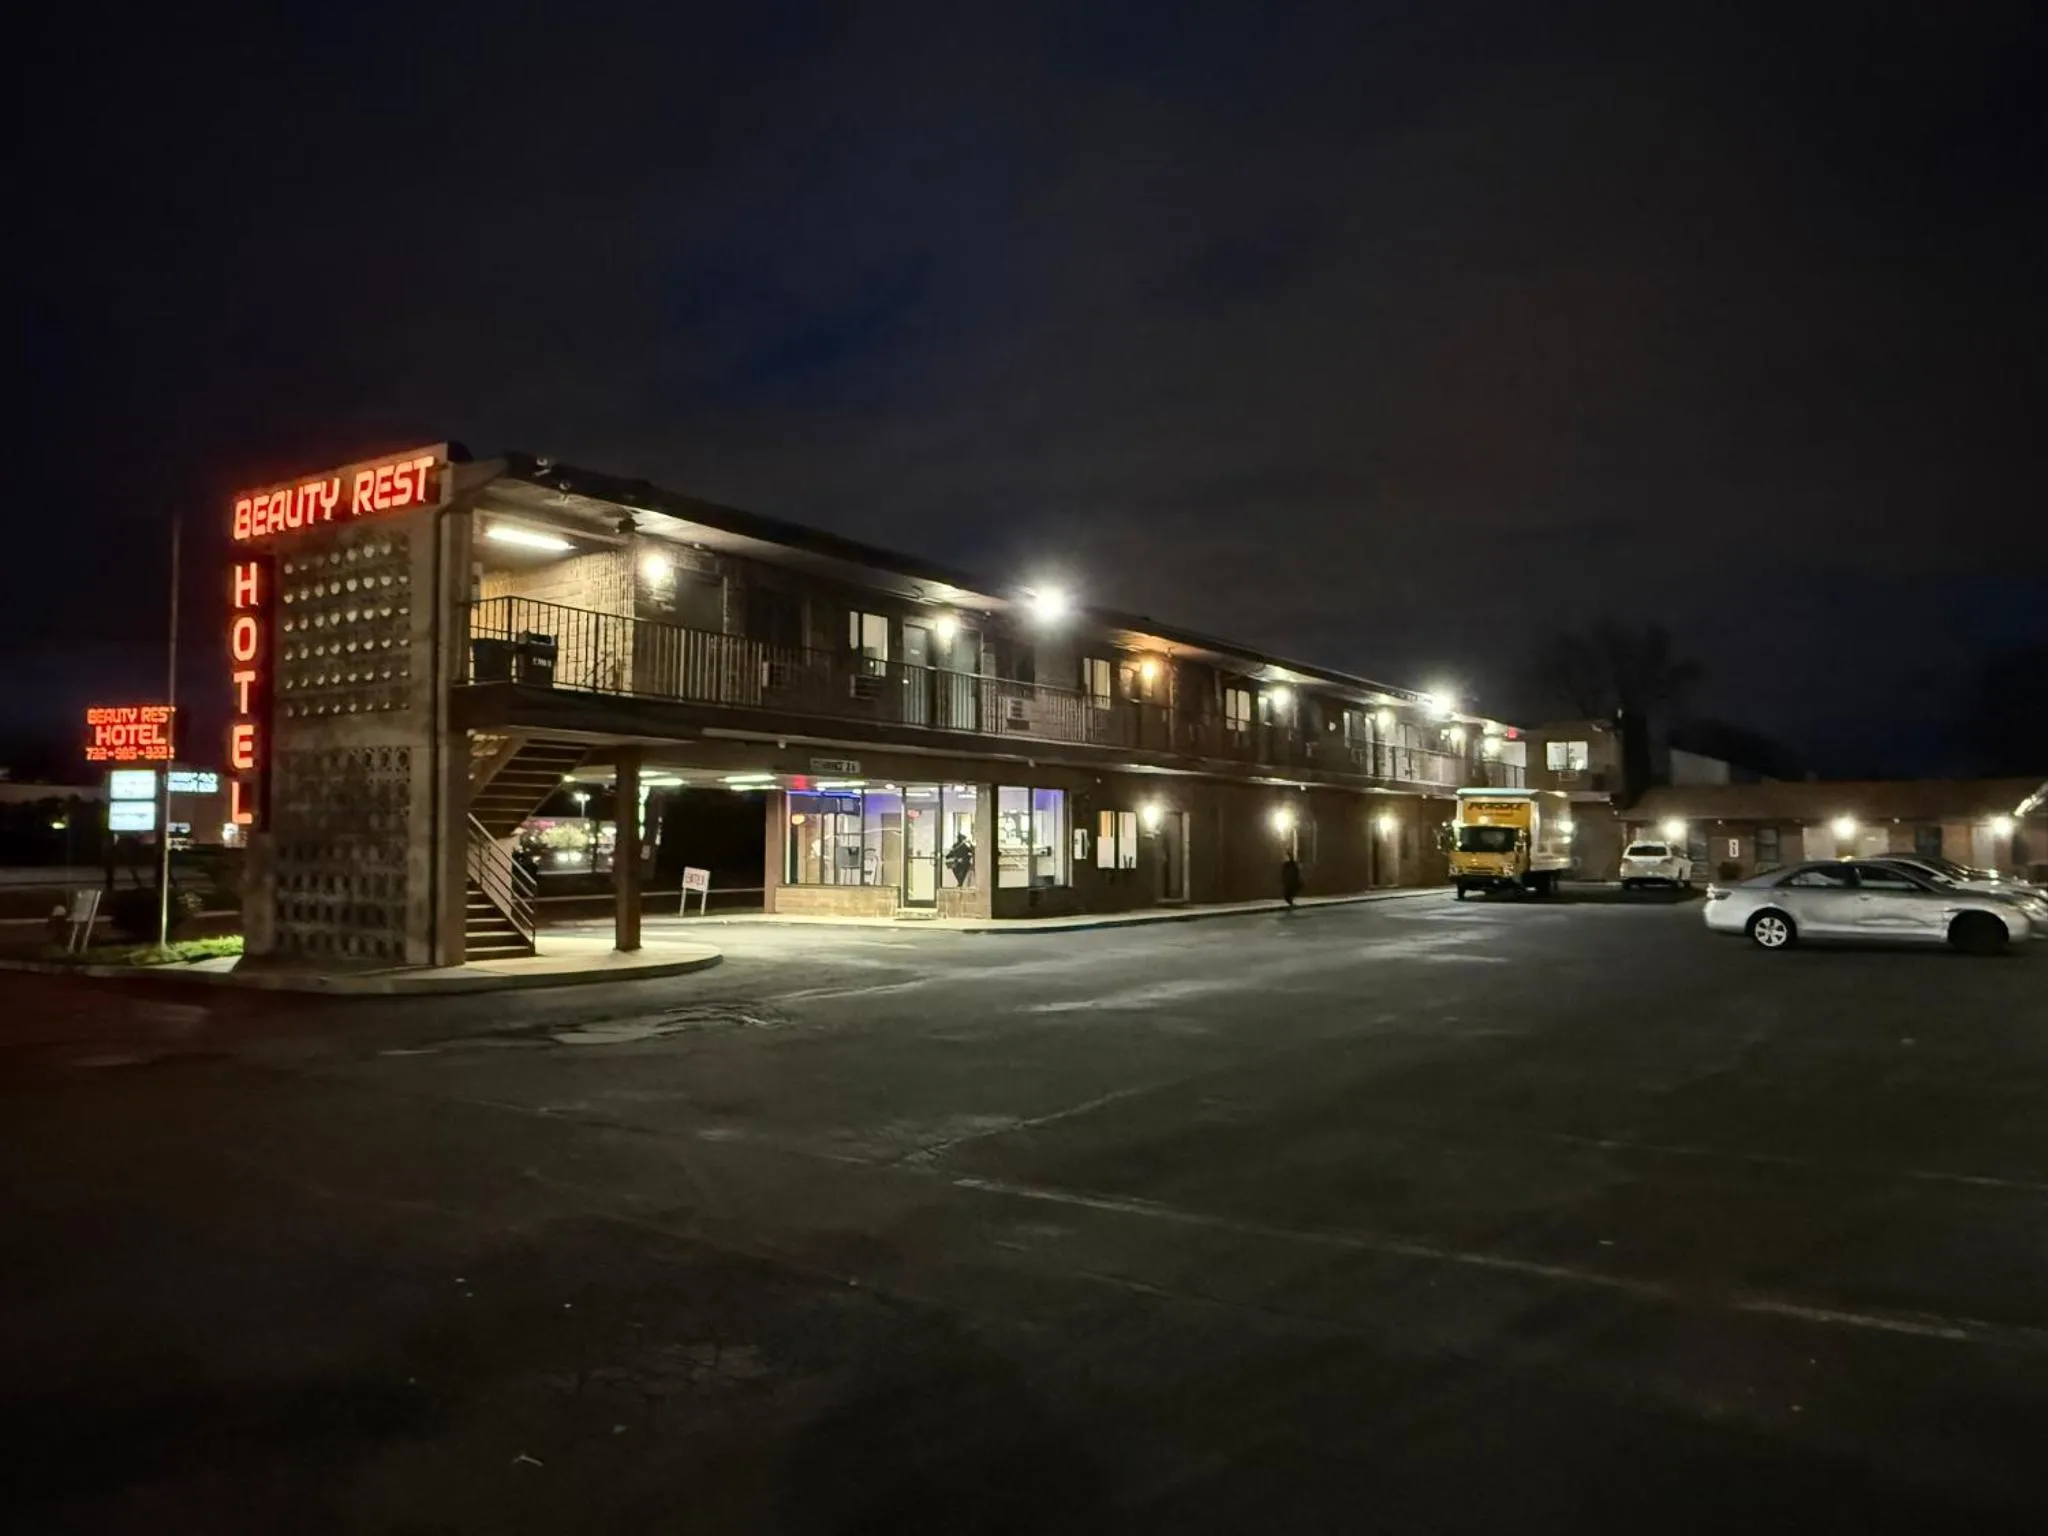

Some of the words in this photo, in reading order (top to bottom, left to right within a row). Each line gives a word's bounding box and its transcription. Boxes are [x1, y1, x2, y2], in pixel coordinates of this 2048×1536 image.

[233, 478, 340, 540] BEAUTY
[352, 456, 435, 515] REST
[86, 708, 138, 725] BEAUTY
[231, 562, 259, 825] HOTEL
[95, 724, 167, 746] HOTEL
